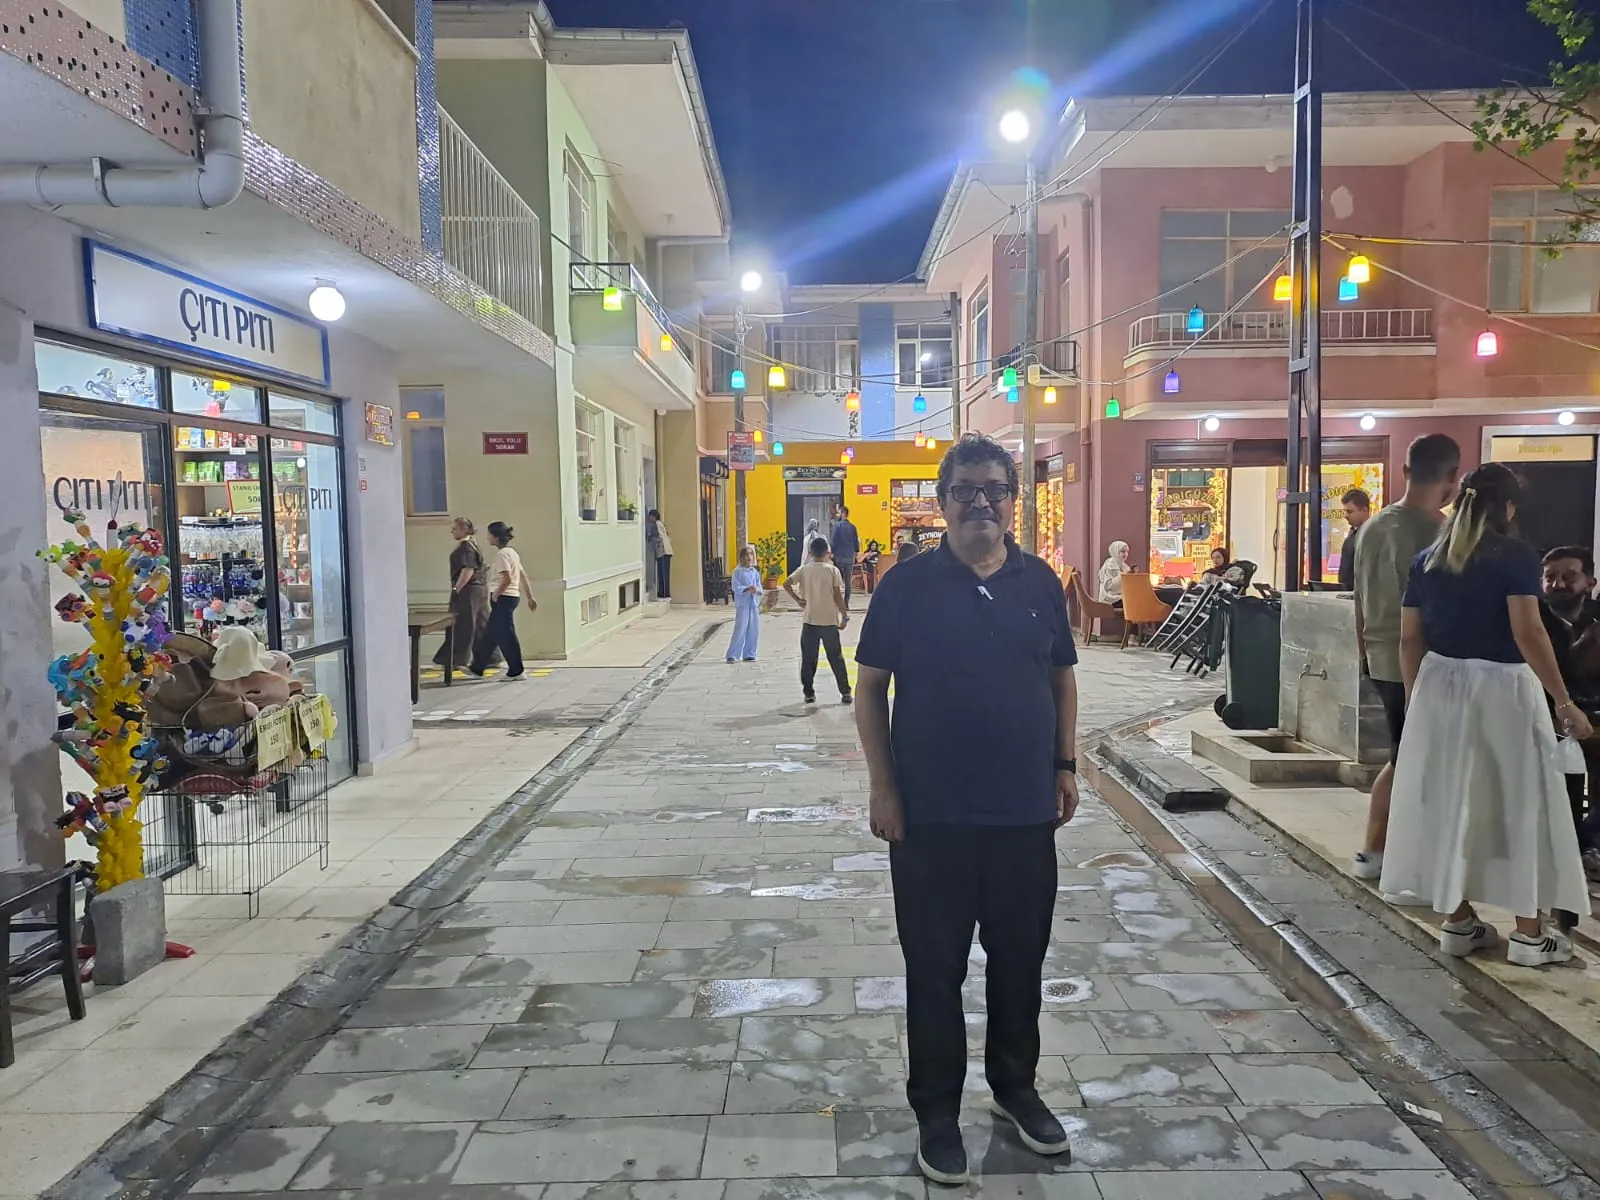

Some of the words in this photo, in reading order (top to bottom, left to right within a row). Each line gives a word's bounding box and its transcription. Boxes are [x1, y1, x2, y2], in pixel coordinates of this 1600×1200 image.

[179, 288, 230, 342] ÇITI
[233, 305, 275, 354] PITI
[309, 487, 332, 510] PITI
